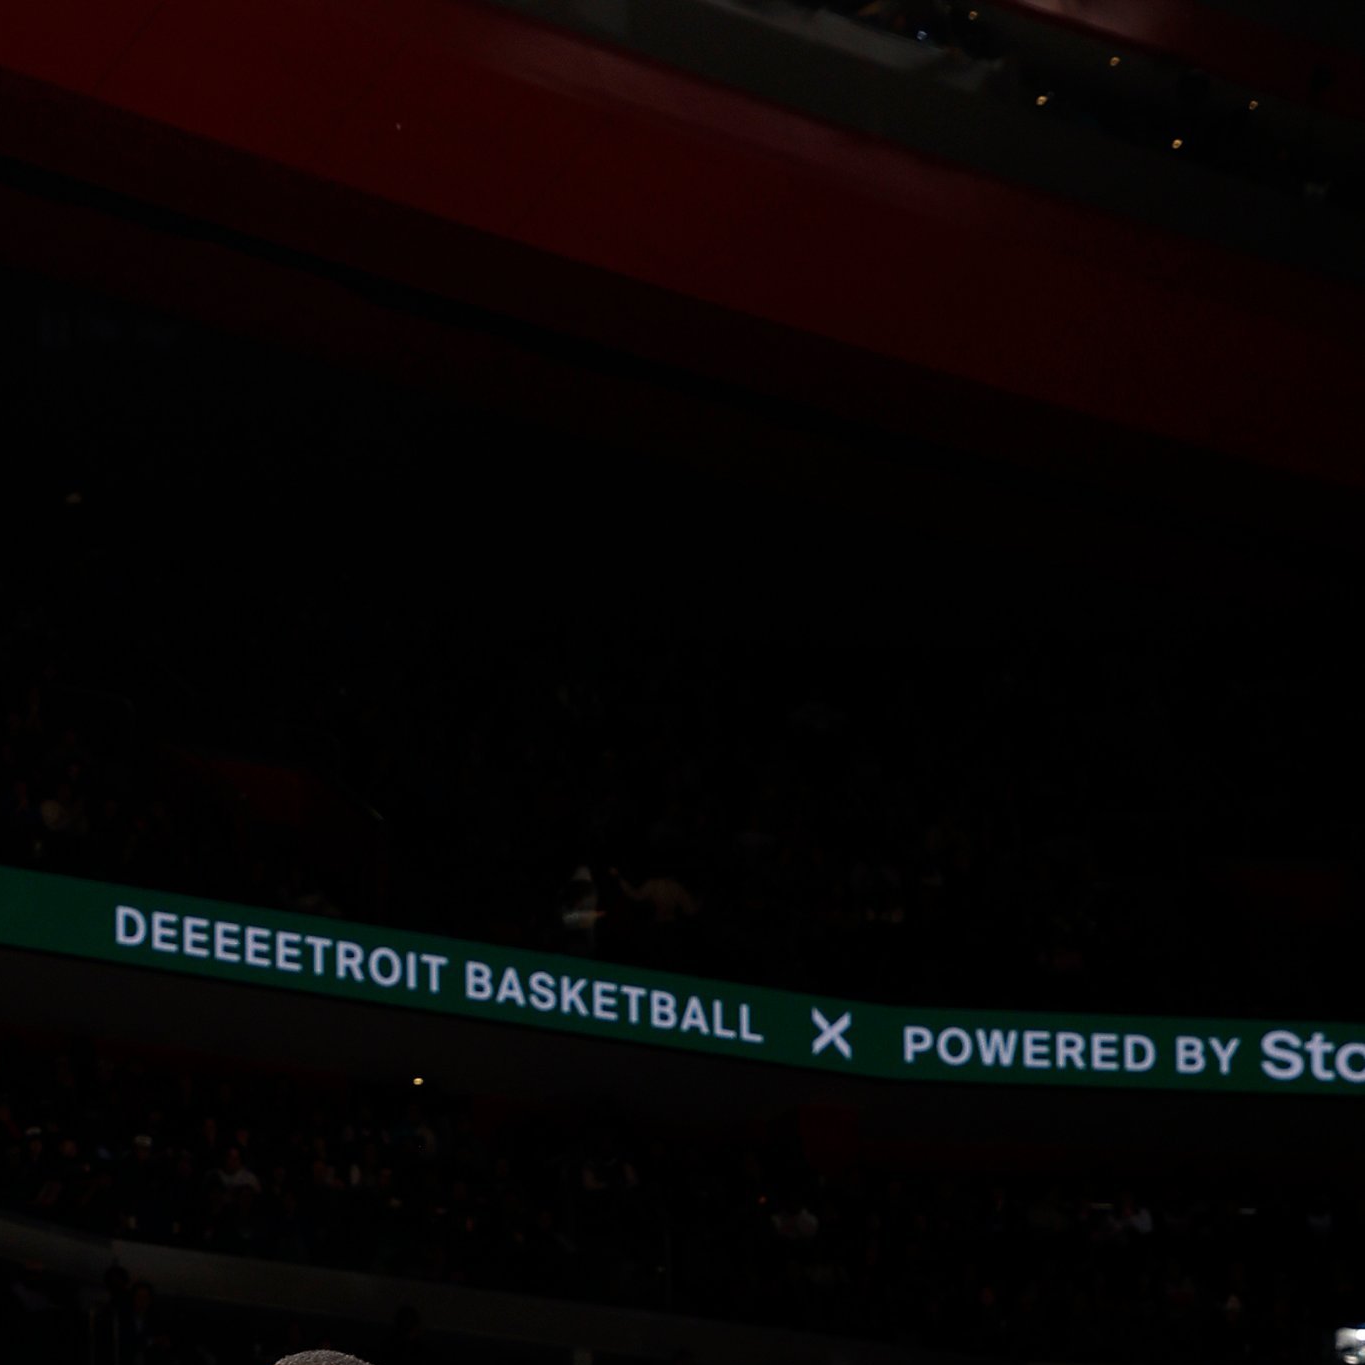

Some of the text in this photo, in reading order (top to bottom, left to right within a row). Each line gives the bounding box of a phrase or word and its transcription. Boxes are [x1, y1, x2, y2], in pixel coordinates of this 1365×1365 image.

[115, 904, 448, 993] DEEEEETROIT
[465, 960, 764, 1043] BASKETBALL
[903, 1025, 1156, 1072] POWERED
[1175, 1035, 1240, 1074] BY
